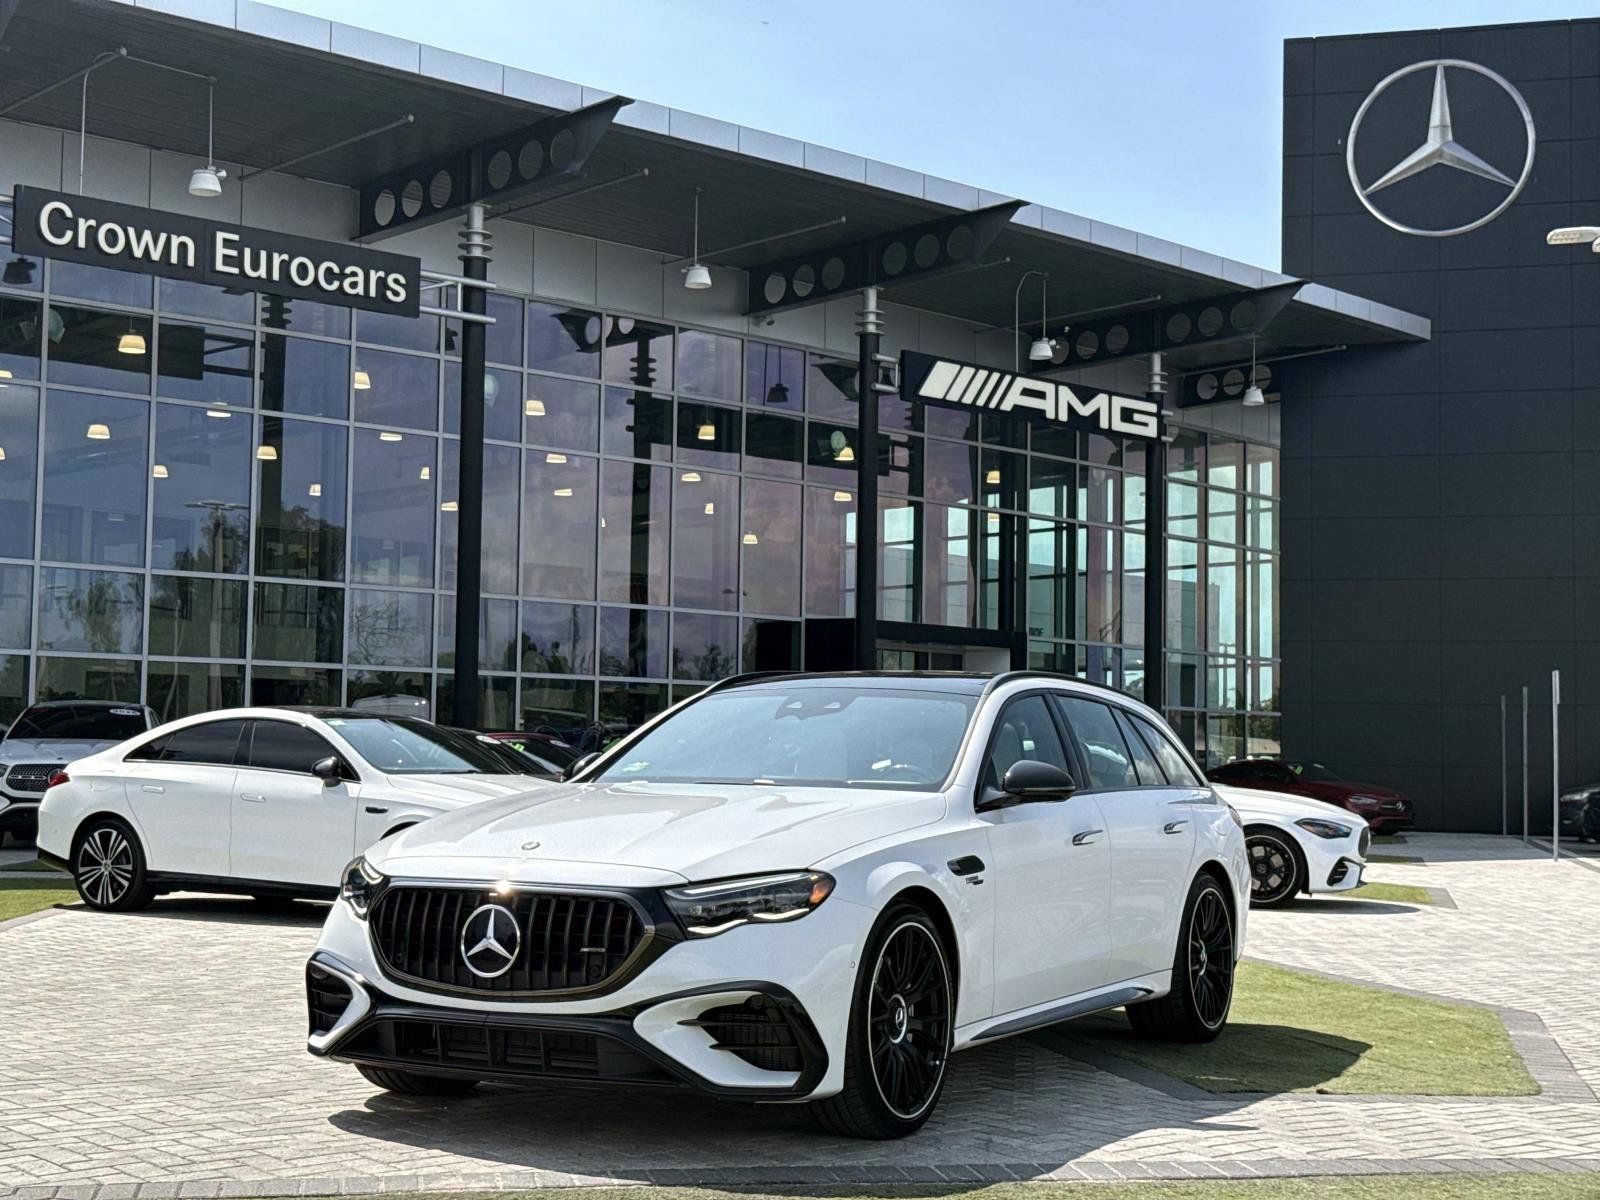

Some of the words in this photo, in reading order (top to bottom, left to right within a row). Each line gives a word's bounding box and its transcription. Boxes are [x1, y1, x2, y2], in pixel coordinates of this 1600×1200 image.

[39, 201, 195, 268] Crown
[215, 231, 408, 303] Eurocars
[999, 376, 1158, 439] AMG
